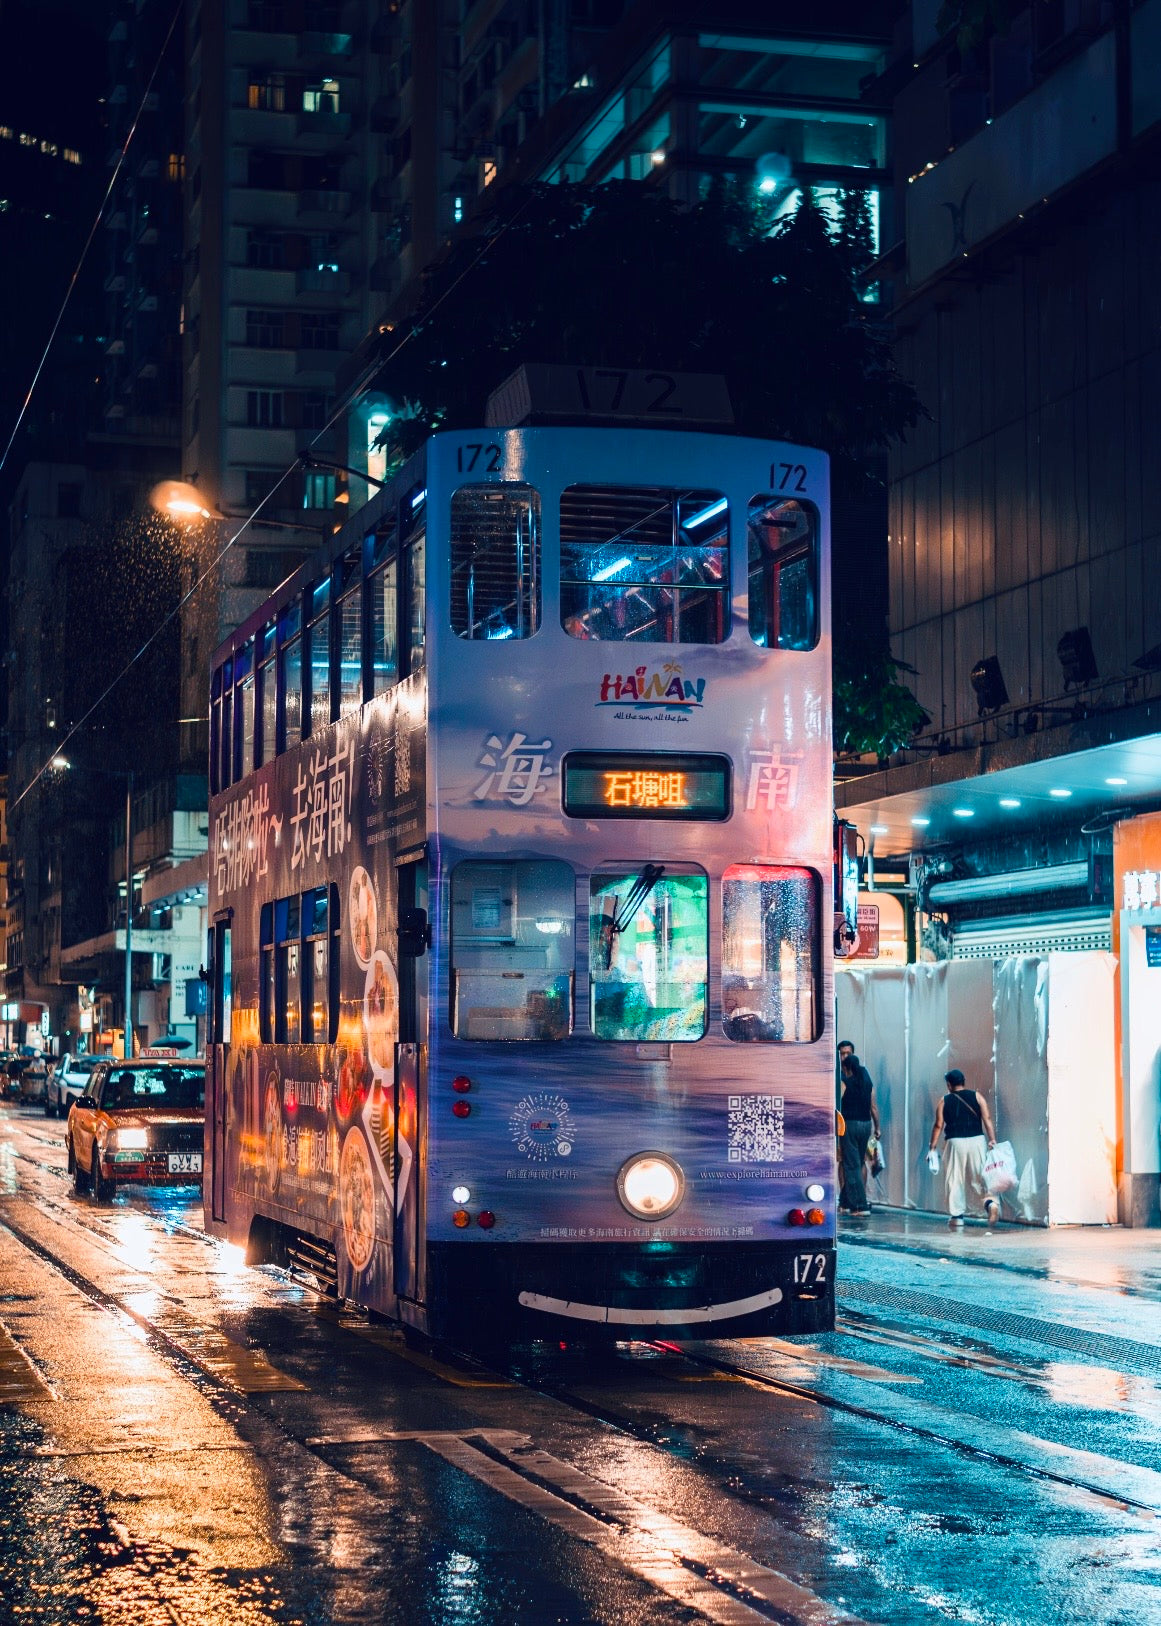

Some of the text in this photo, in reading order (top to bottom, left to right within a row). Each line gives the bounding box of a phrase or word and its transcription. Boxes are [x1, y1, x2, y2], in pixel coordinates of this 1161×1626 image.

[577, 368, 683, 413] 172
[457, 445, 501, 473] 172
[769, 463, 807, 492] 172
[625, 711, 637, 720] the
[665, 713, 675, 721] the
[676, 714, 689, 724] fun
[474, 733, 805, 812] 海 南
[604, 772, 688, 807] 石塘咀
[178, 1155, 192, 1164] VW
[793, 1253, 827, 1283] 172
